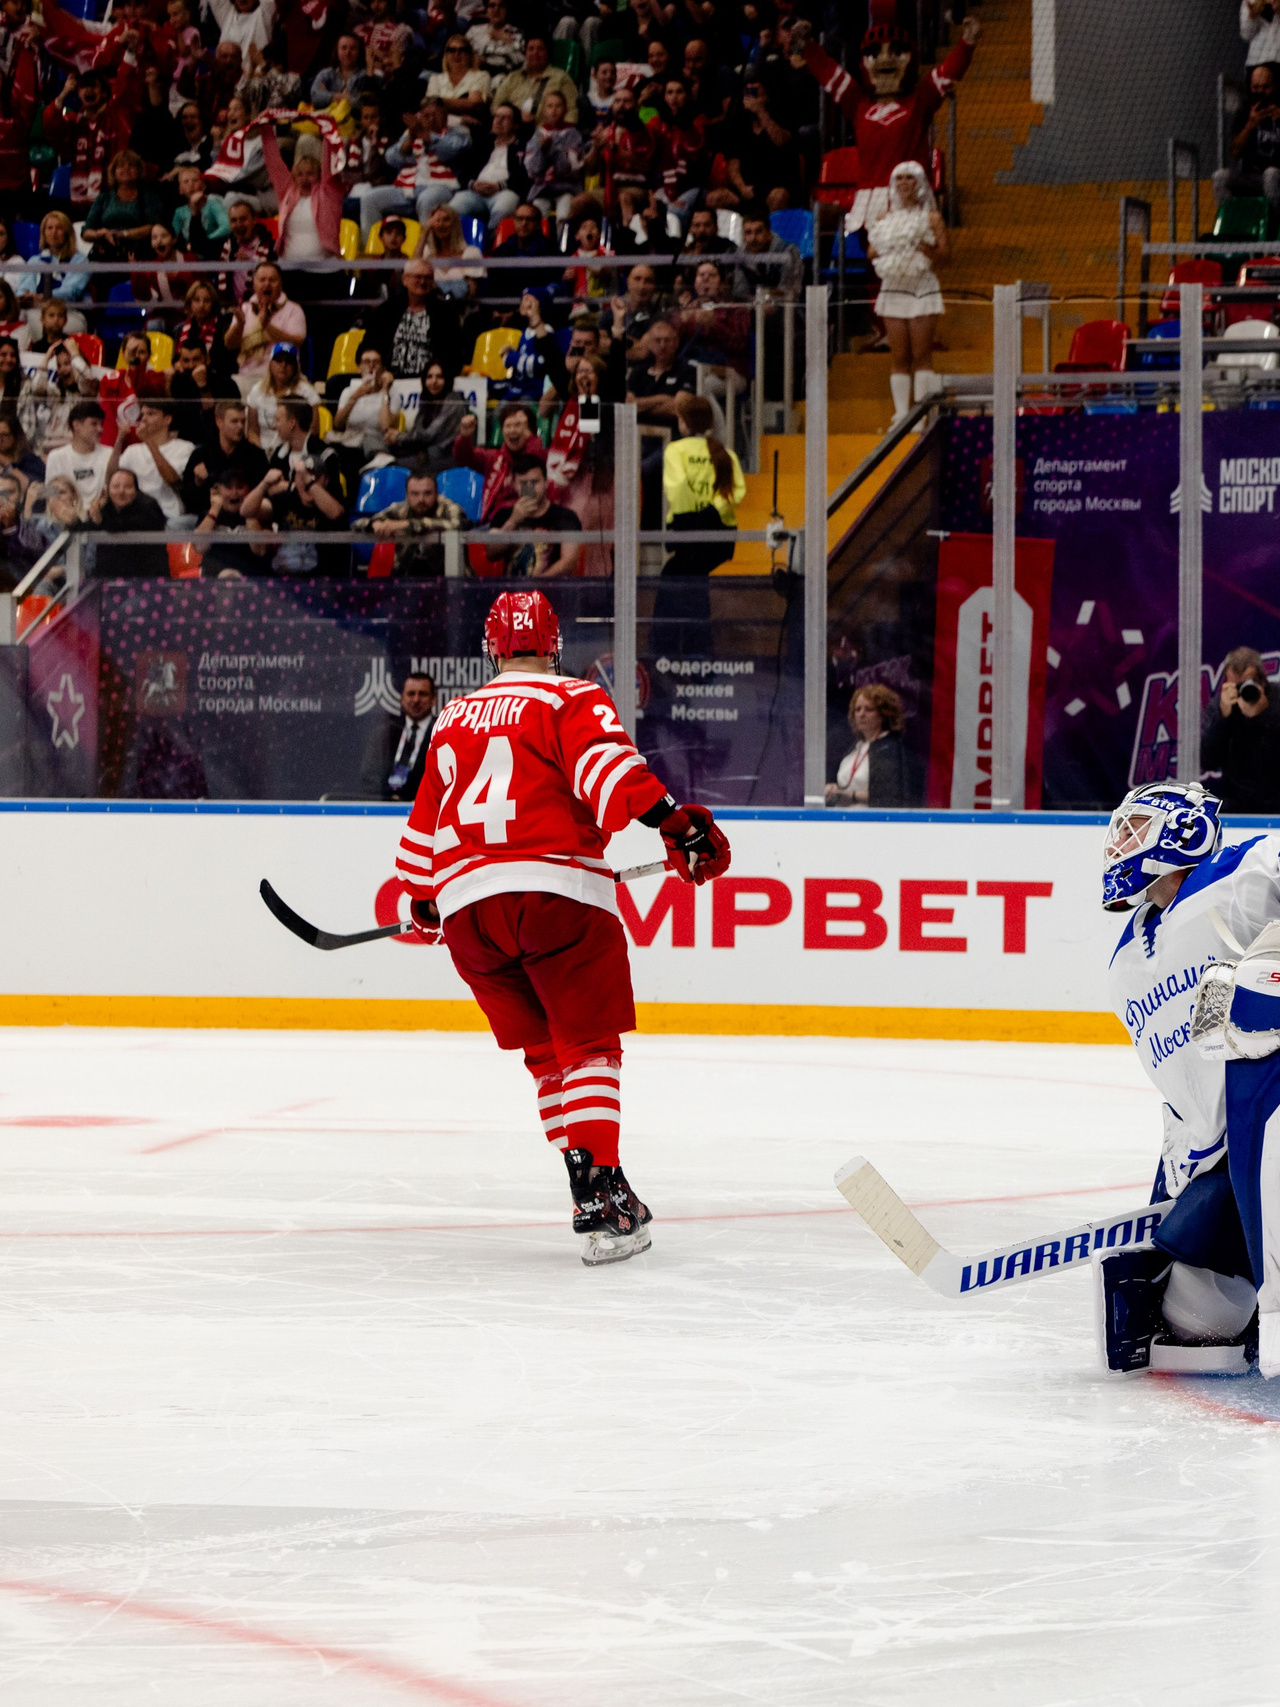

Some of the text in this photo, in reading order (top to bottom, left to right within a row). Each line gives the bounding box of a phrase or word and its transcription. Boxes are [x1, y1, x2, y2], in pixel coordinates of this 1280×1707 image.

[1033, 457, 1128, 475] Департамент
[1033, 478, 1082, 494] спорта
[1033, 496, 1142, 514] города Москвы
[1219, 486, 1277, 514] СПОРТ
[512, 611, 533, 631] 24
[198, 652, 305, 671] Департамент
[655, 656, 755, 677] Федерация
[198, 675, 255, 693] спорта
[675, 683, 734, 698] хоккея
[198, 695, 322, 713] города Москвы
[671, 703, 739, 721] Москвы
[432, 735, 517, 856] 24
[959, 1212, 1163, 1294] WARRIOR
